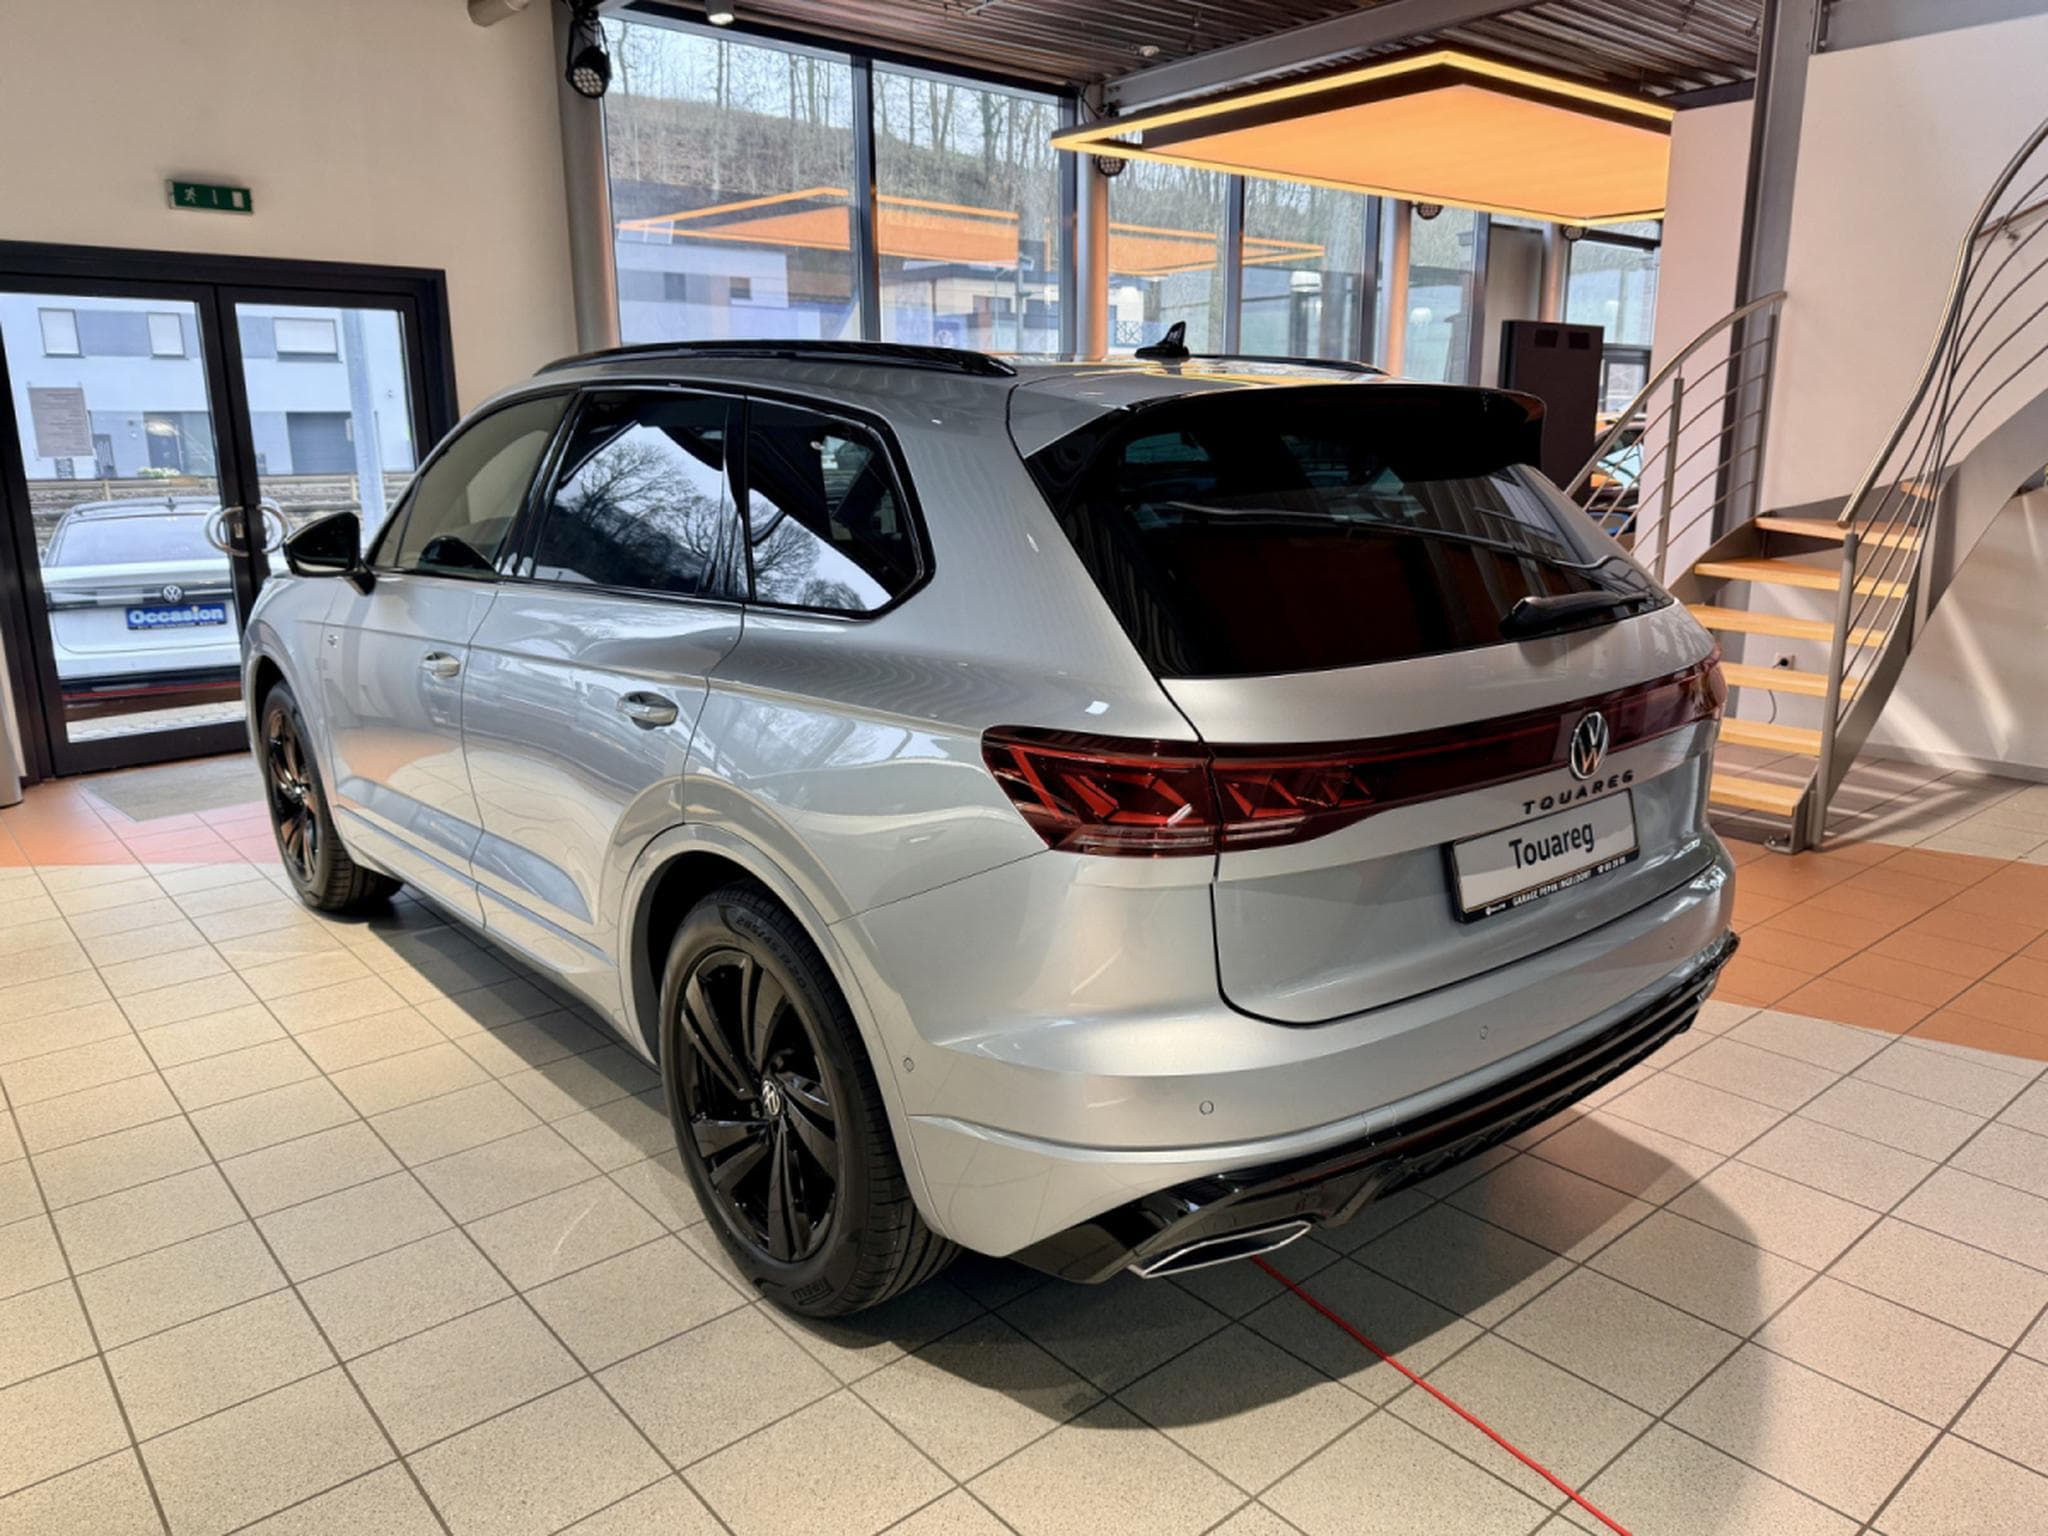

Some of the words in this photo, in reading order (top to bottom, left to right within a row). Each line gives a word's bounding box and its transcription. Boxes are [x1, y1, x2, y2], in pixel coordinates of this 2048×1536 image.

[128, 605, 224, 624] Occasion
[1522, 769, 1635, 815] TOUAREG
[1508, 822, 1594, 869] Touareg
